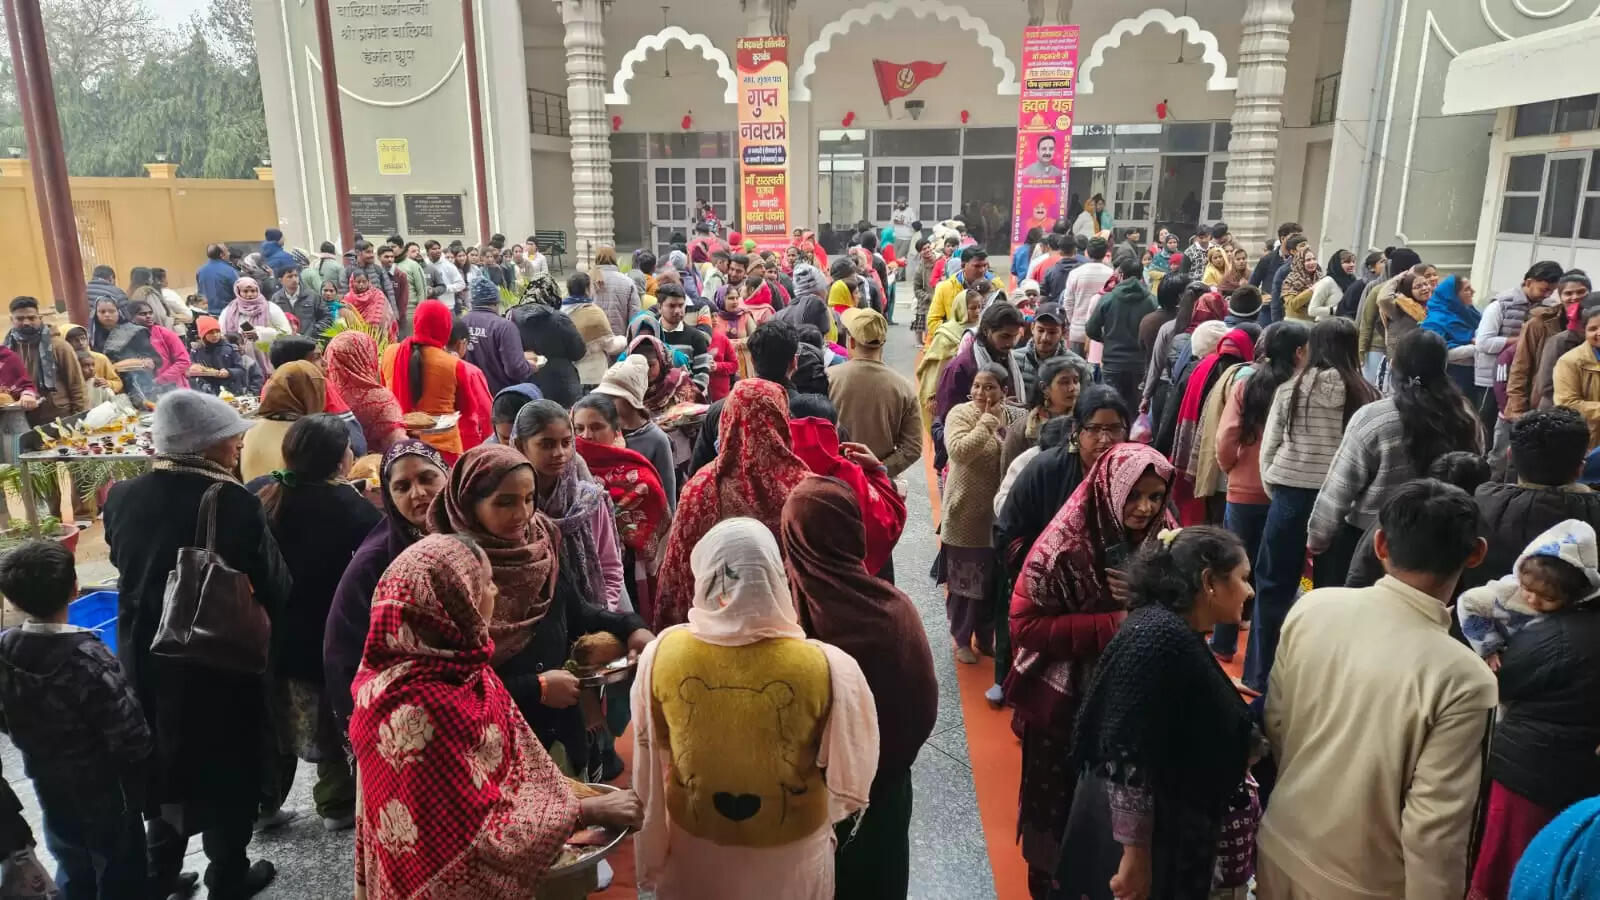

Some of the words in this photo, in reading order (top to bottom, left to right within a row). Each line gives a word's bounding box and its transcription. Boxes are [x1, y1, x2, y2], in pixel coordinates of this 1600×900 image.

[336, 1, 377, 17] वालिया
[341, 25, 356, 40] श्री
[358, 24, 390, 41] प्रमोद
[391, 21, 432, 39] वालिया
[361, 48, 391, 64] हेमंत
[748, 88, 778, 118] गुप्त
[1022, 99, 1049, 113] हवन
[1051, 99, 1073, 113] यज्ञ
[741, 114, 786, 140] नवरात्रे
[756, 174, 785, 186] सरस्वती
